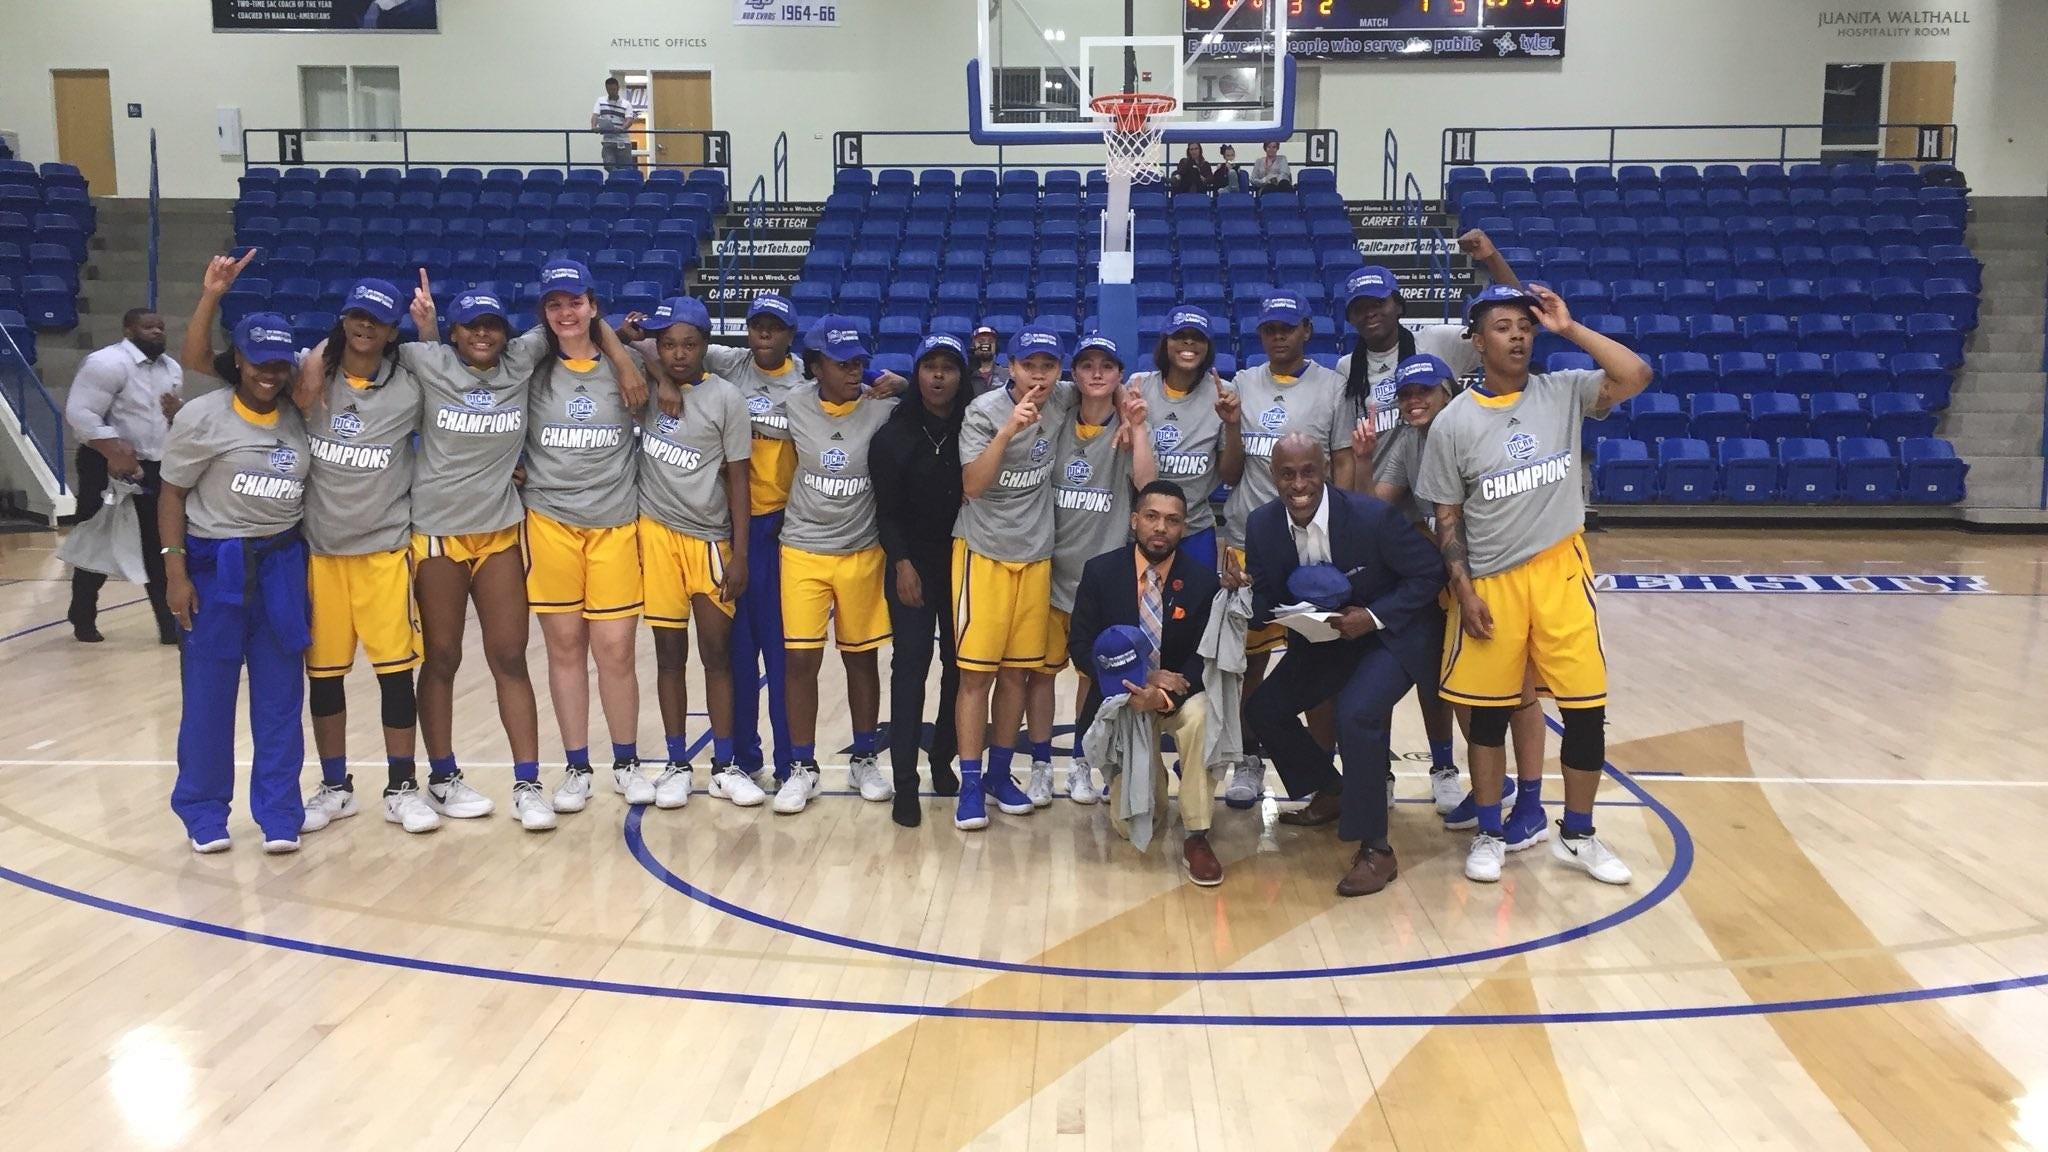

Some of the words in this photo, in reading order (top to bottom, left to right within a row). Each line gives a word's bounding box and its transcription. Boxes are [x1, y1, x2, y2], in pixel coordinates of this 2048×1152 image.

[278, 0, 297, 8] COACH
[297, 0, 305, 8] OF
[306, 0, 317, 8] THE
[317, 0, 333, 8] YEAR
[237, 12, 263, 20] COACHED
[286, 12, 331, 20] ALL-AMERICANS
[782, 5, 836, 21] 1964-66
[1818, 12, 1881, 28] JUANITA
[1887, 11, 1971, 24] WALTHALL
[1359, 18, 1389, 27] MATCH
[1837, 27, 1910, 37] HOSPITALITY
[1914, 27, 1950, 37] ROOM
[610, 38, 660, 48] ATHLETIC
[665, 38, 707, 48] OFFICES
[1188, 38, 1276, 56] Epowering
[1286, 37, 1329, 55] eople
[1331, 37, 1362, 53] who
[1363, 39, 1405, 53] serve
[1406, 36, 1432, 53] the
[1519, 33, 1556, 53] tyler
[284, 134, 297, 161] F
[708, 136, 721, 164] F
[843, 137, 858, 165] G
[1310, 134, 1325, 162] G
[1455, 132, 1472, 160] H
[1922, 130, 1939, 158] H
[1364, 205, 1382, 213] Home
[1424, 205, 1437, 213] Call
[783, 218, 808, 229] TECH
[1361, 216, 1402, 227] CARPET
[764, 273, 787, 282] Wreck,
[1393, 273, 1410, 281] ome
[1457, 272, 1471, 280] Call
[1399, 288, 1431, 299] ARPET
[437, 408, 521, 433] CHAMPIONS
[541, 427, 622, 448] CHAMPIONS
[1595, 575, 1997, 593] ERSITY
